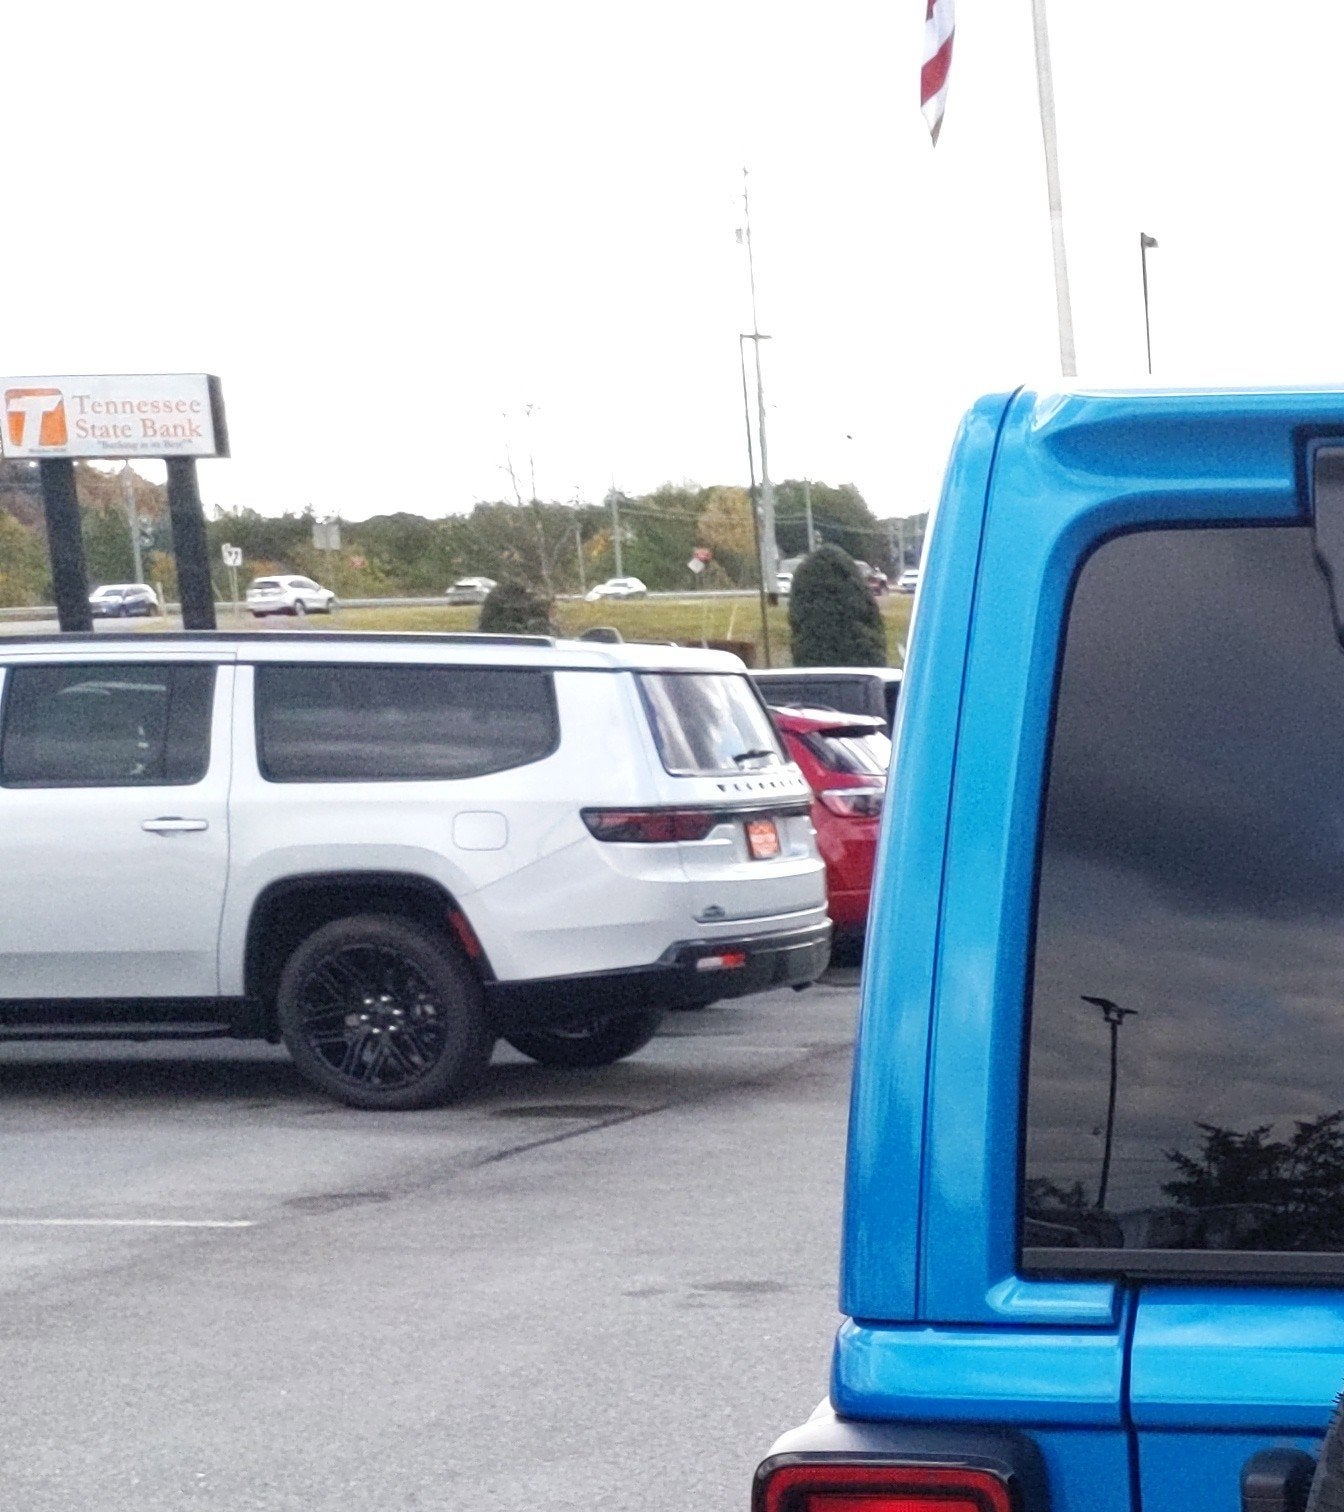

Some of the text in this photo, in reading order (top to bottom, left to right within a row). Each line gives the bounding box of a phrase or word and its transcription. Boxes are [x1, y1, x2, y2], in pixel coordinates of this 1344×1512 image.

[72, 395, 201, 415] Tennessee
[76, 417, 202, 439] State Bank
